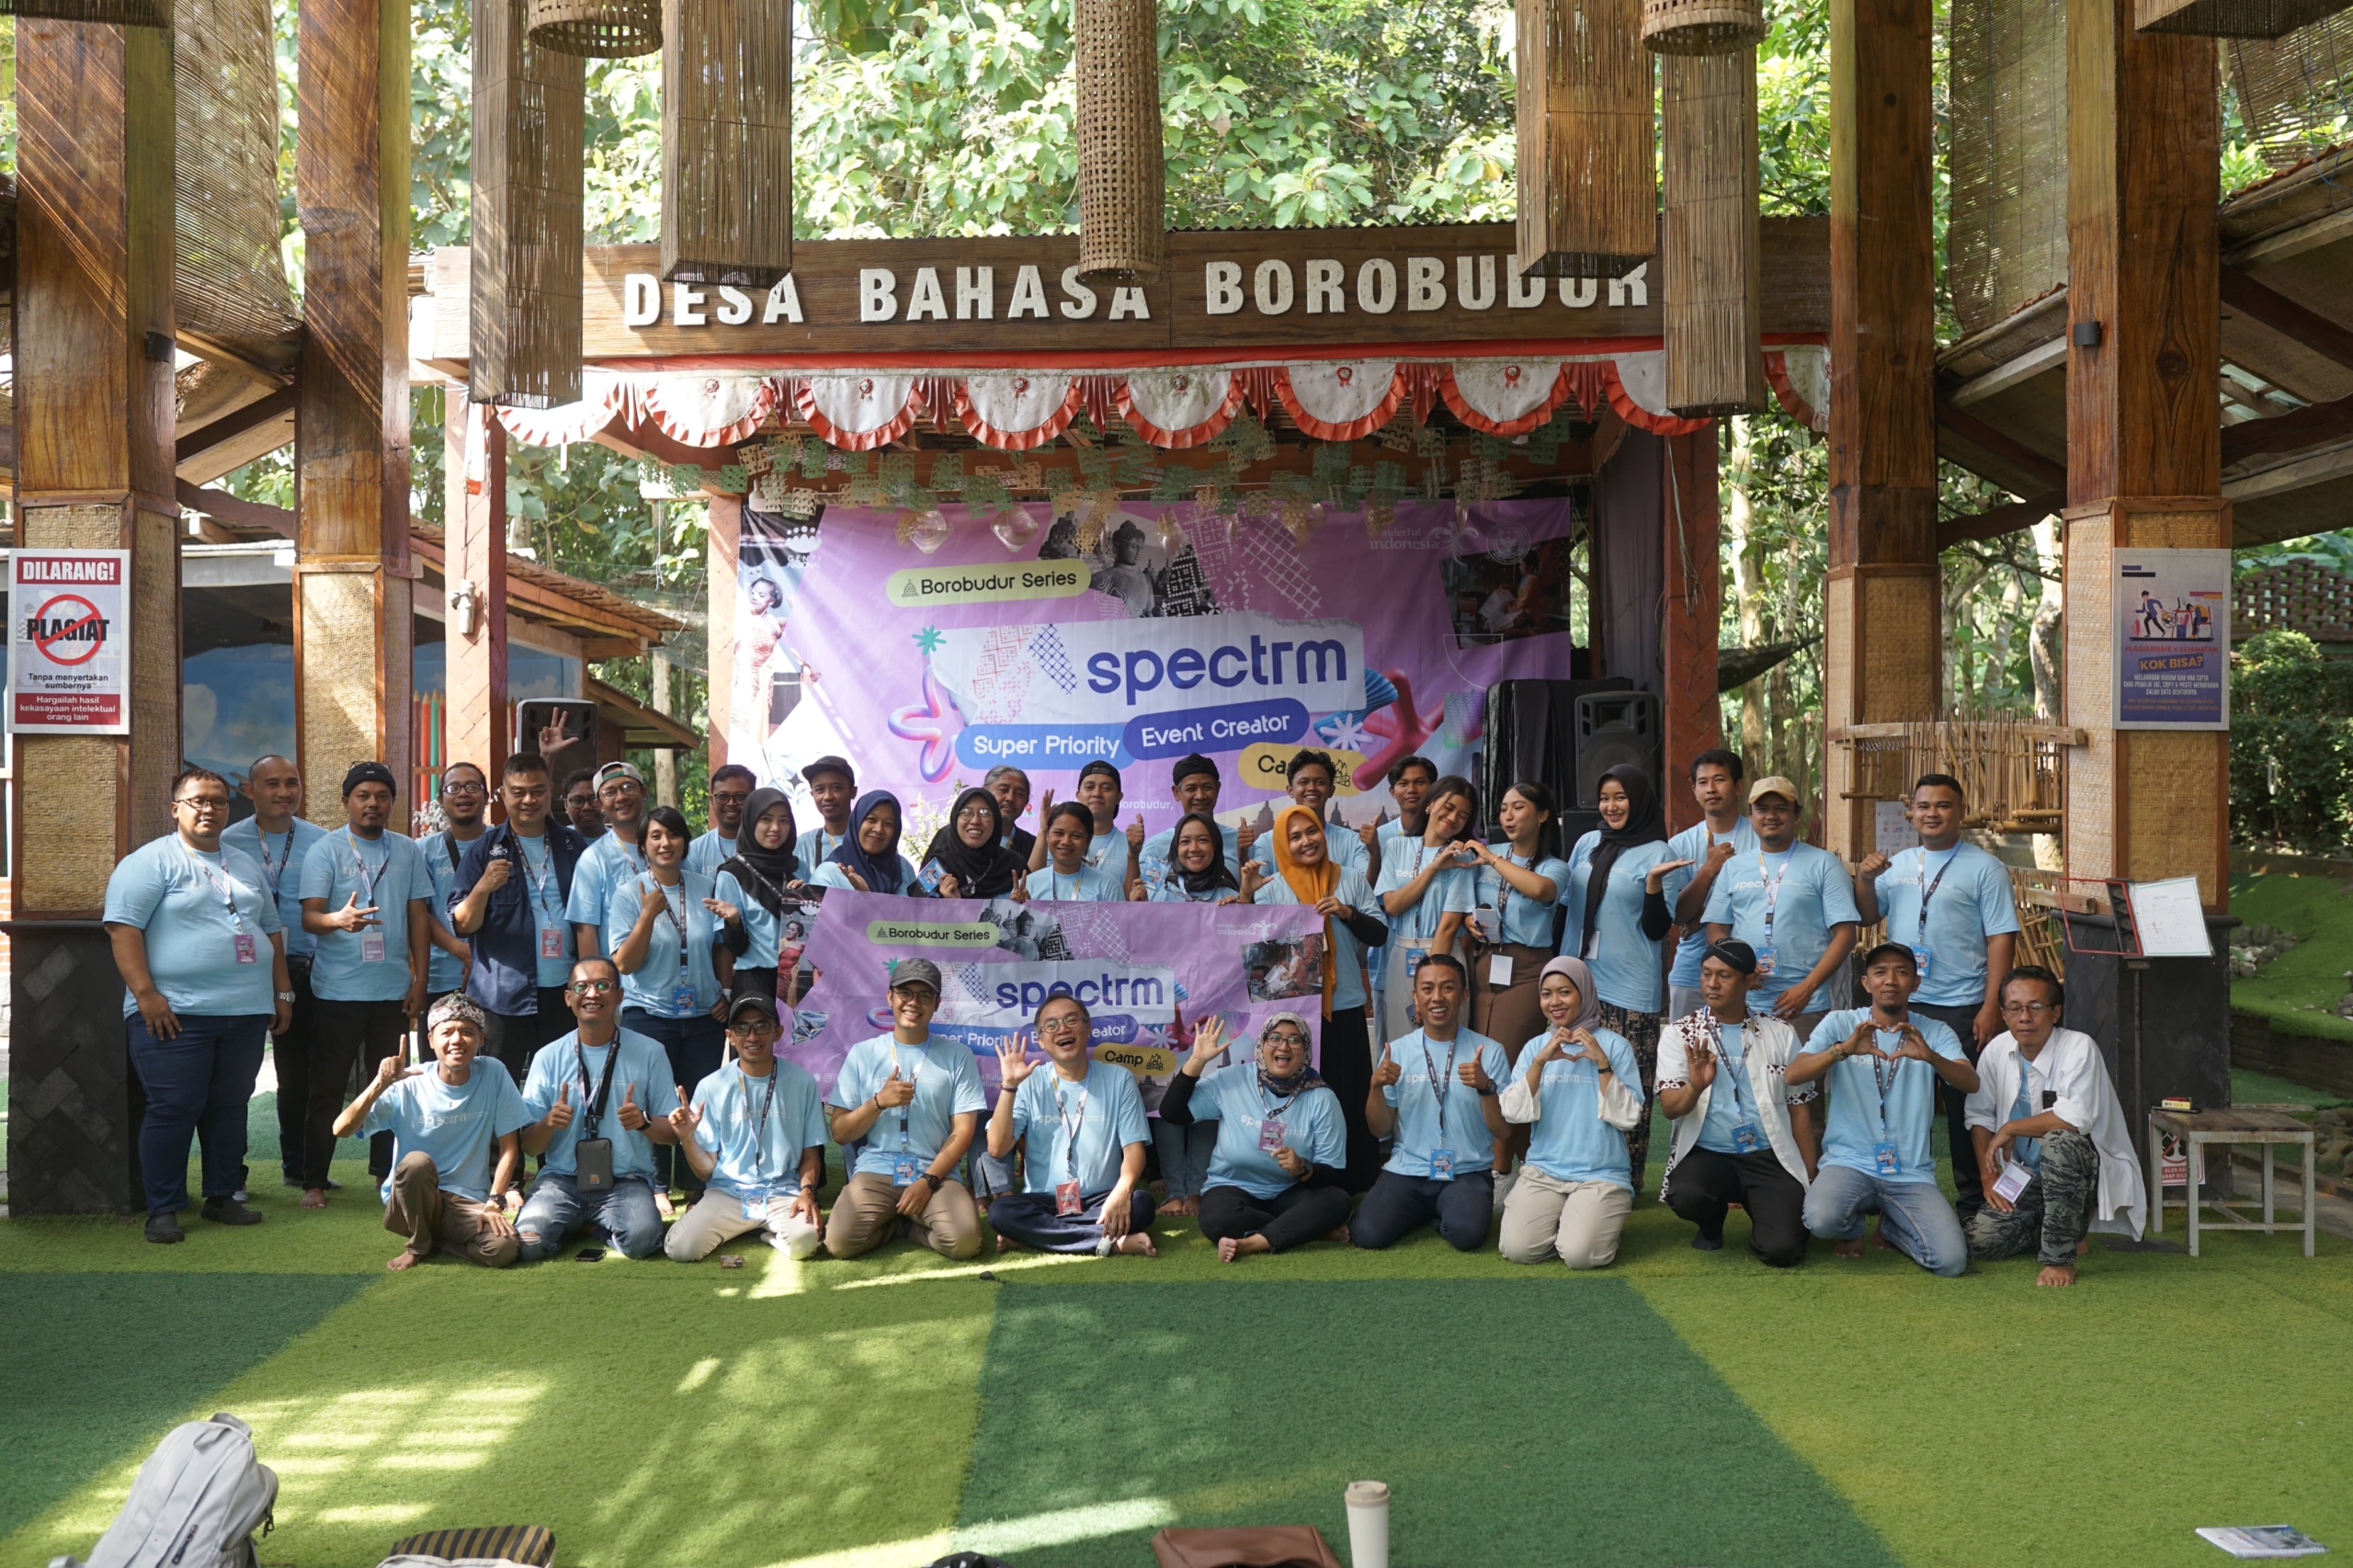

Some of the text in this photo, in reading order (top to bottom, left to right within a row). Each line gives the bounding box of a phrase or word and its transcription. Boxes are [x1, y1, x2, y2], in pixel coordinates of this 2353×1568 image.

[624, 255, 1649, 326] DESA BAHASA BOROBUDUR
[23, 562, 116, 581] DILARANG!
[921, 571, 1076, 595] Borobudur Series
[28, 619, 109, 641] PLAGIAT
[1086, 634, 1347, 706] spectrm
[2141, 655, 2203, 670] KOK BISA?
[28, 674, 108, 683] Tanpa menyertakan
[45, 682, 92, 691] sumbernya
[37, 696, 77, 705] Hargailah
[72, 705, 116, 713] intelektual
[47, 714, 73, 722] orang
[1142, 715, 1290, 747] Event Creator
[973, 734, 1120, 759] Super Priority
[1257, 754, 1288, 776] Ca
[889, 927, 990, 941] Borobudur Series
[1105, 1050, 1143, 1065] Camp
